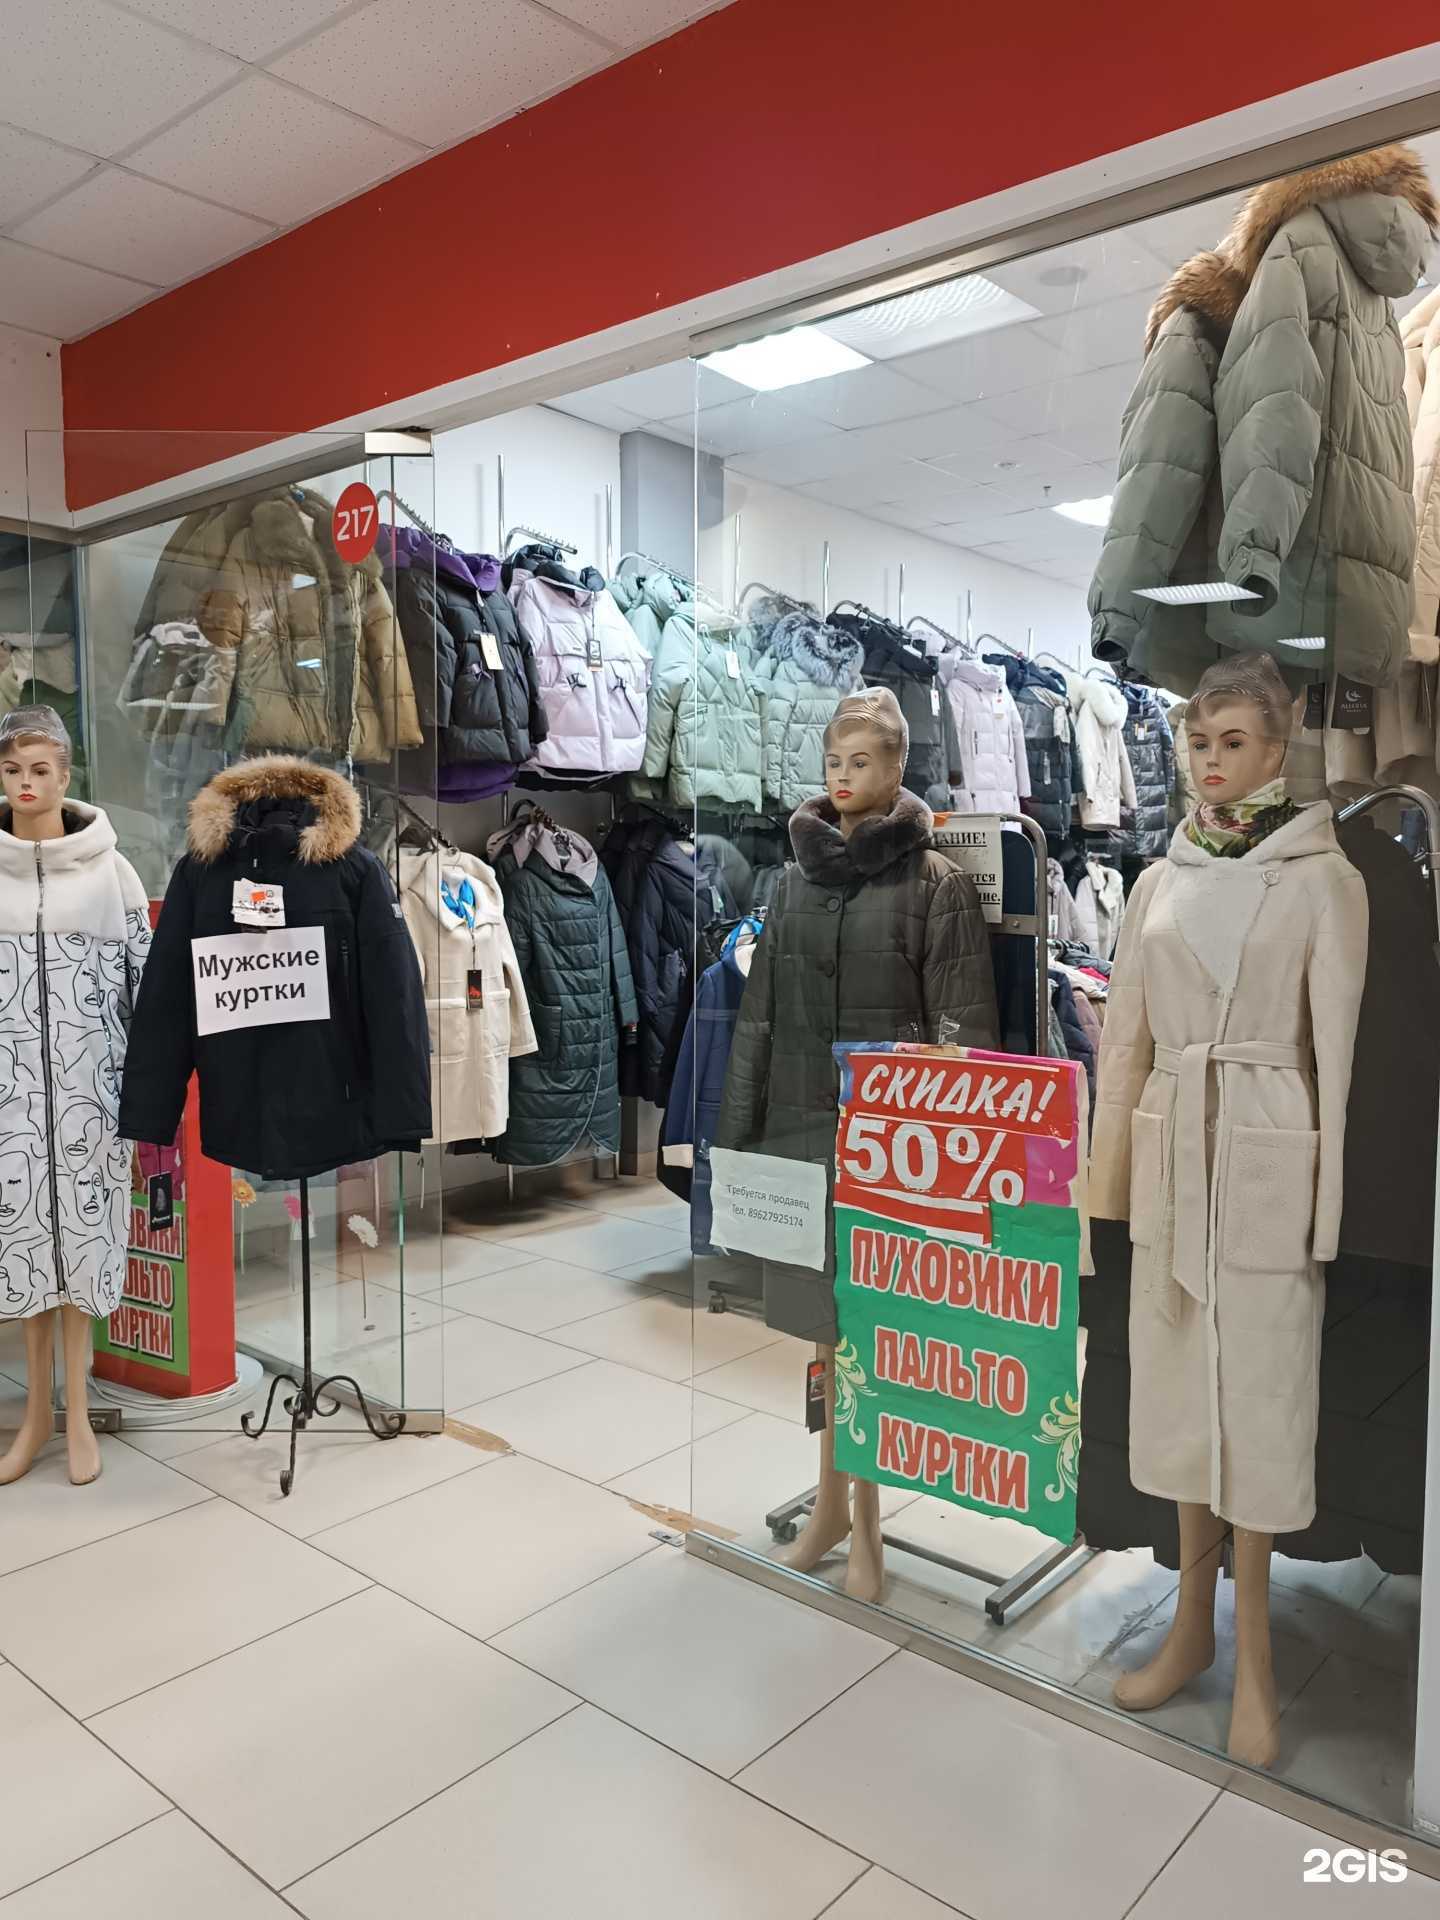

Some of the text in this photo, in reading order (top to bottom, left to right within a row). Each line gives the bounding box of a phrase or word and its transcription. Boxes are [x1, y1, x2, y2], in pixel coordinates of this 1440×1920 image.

[336, 504, 375, 541] 217
[198, 949, 320, 981] Мужские
[215, 982, 306, 1012] куртки
[860, 1063, 1057, 1124] СКИДКА!
[843, 1116, 1025, 1207] 50%
[726, 1184, 810, 1210] Требуется продавец
[732, 1203, 803, 1228] Тел. 89627925174
[851, 1225, 1061, 1330] ПУХОВИКИ
[108, 1304, 173, 1359] КУРТКИ
[874, 1325, 1028, 1416] ПАЛЬТО
[877, 1412, 1029, 1512] КУРТКИ
